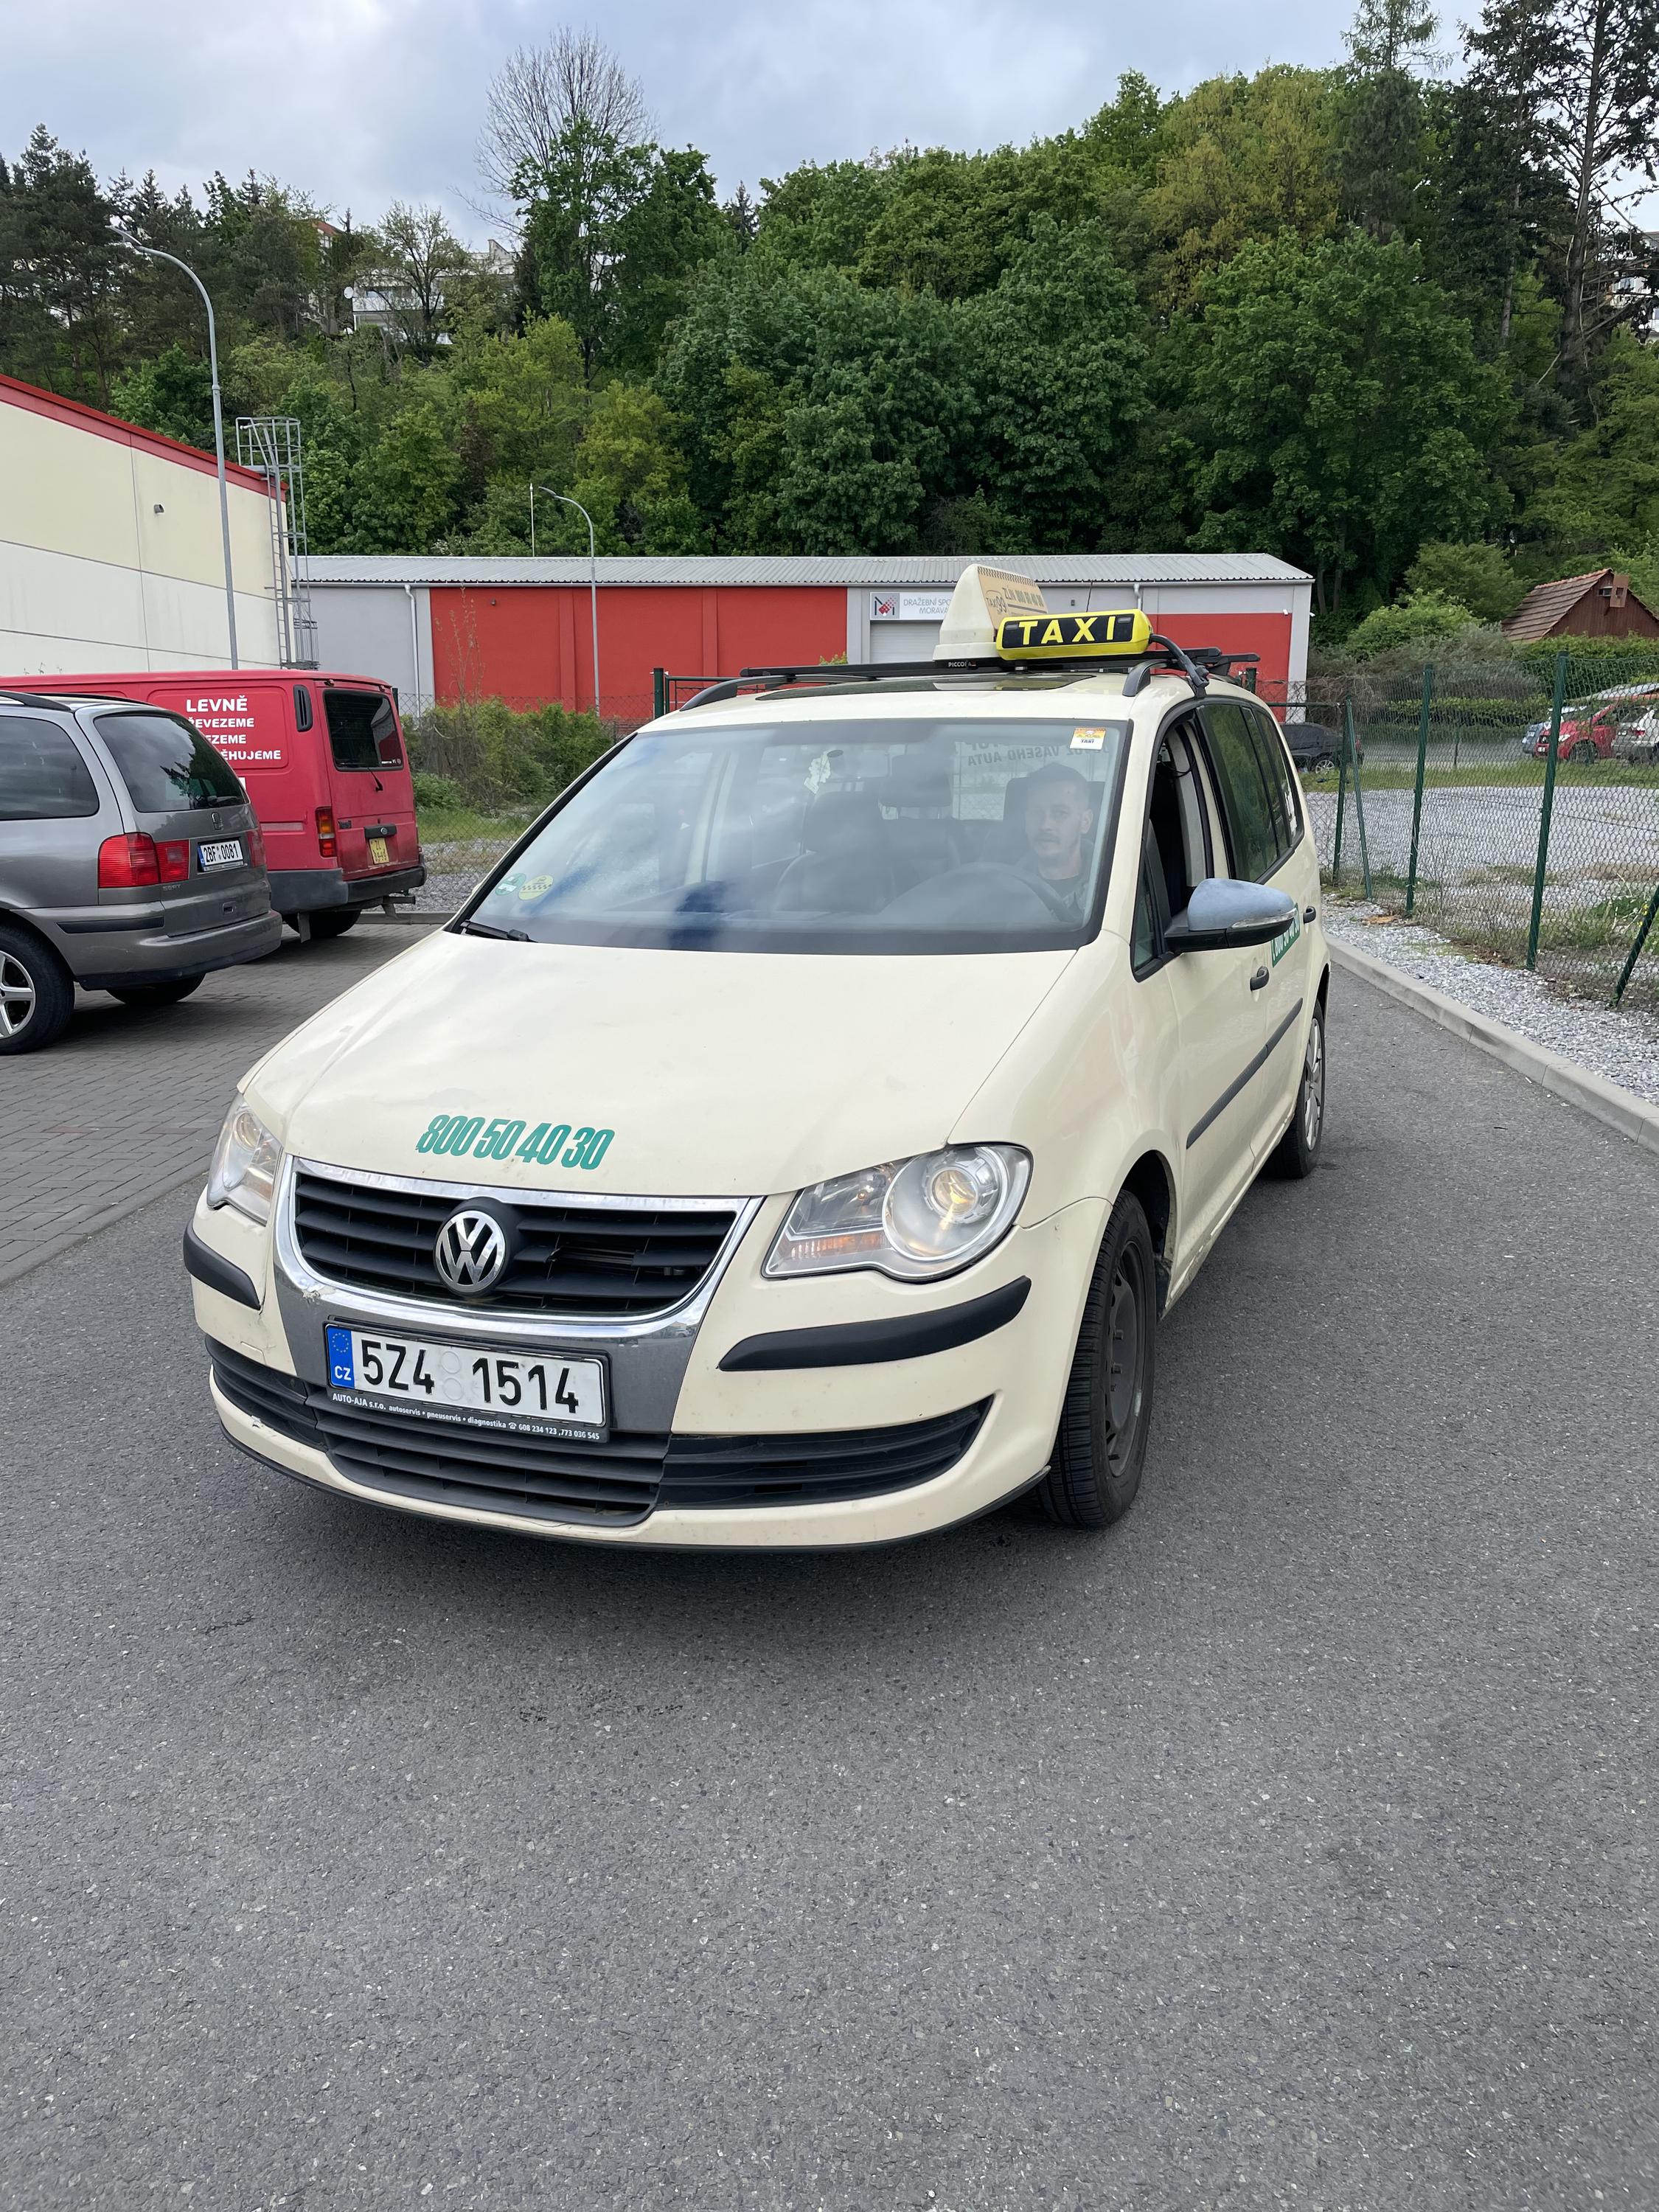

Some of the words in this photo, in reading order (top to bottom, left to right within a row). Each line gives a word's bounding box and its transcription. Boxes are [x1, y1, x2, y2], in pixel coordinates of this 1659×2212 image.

[903, 597, 937, 606] DRAŽEBNÍ
[939, 597, 951, 606] SPO
[1018, 616, 1116, 645] TAXI
[186, 695, 248, 712] LEVNĚ
[188, 717, 254, 728] ŘEVEZEME
[205, 734, 246, 745] EZEME
[220, 749, 282, 760] ĚHUJEME
[204, 846, 216, 863] 2BF
[221, 843, 239, 860] 0081
[334, 1365, 352, 1381] CZ
[361, 1339, 435, 1395] 5Z4
[472, 1357, 580, 1413] 1514
[332, 1393, 368, 1407] AUTO-AJA
[369, 1401, 386, 1411] s.r.o.
[389, 1405, 421, 1416] autoservis
[426, 1411, 462, 1422] pneuservis
[467, 1416, 507, 1429] diagnostika
[532, 1425, 544, 1433] 234
[545, 1427, 557, 1435] 123
[587, 1432, 600, 1440] 545
